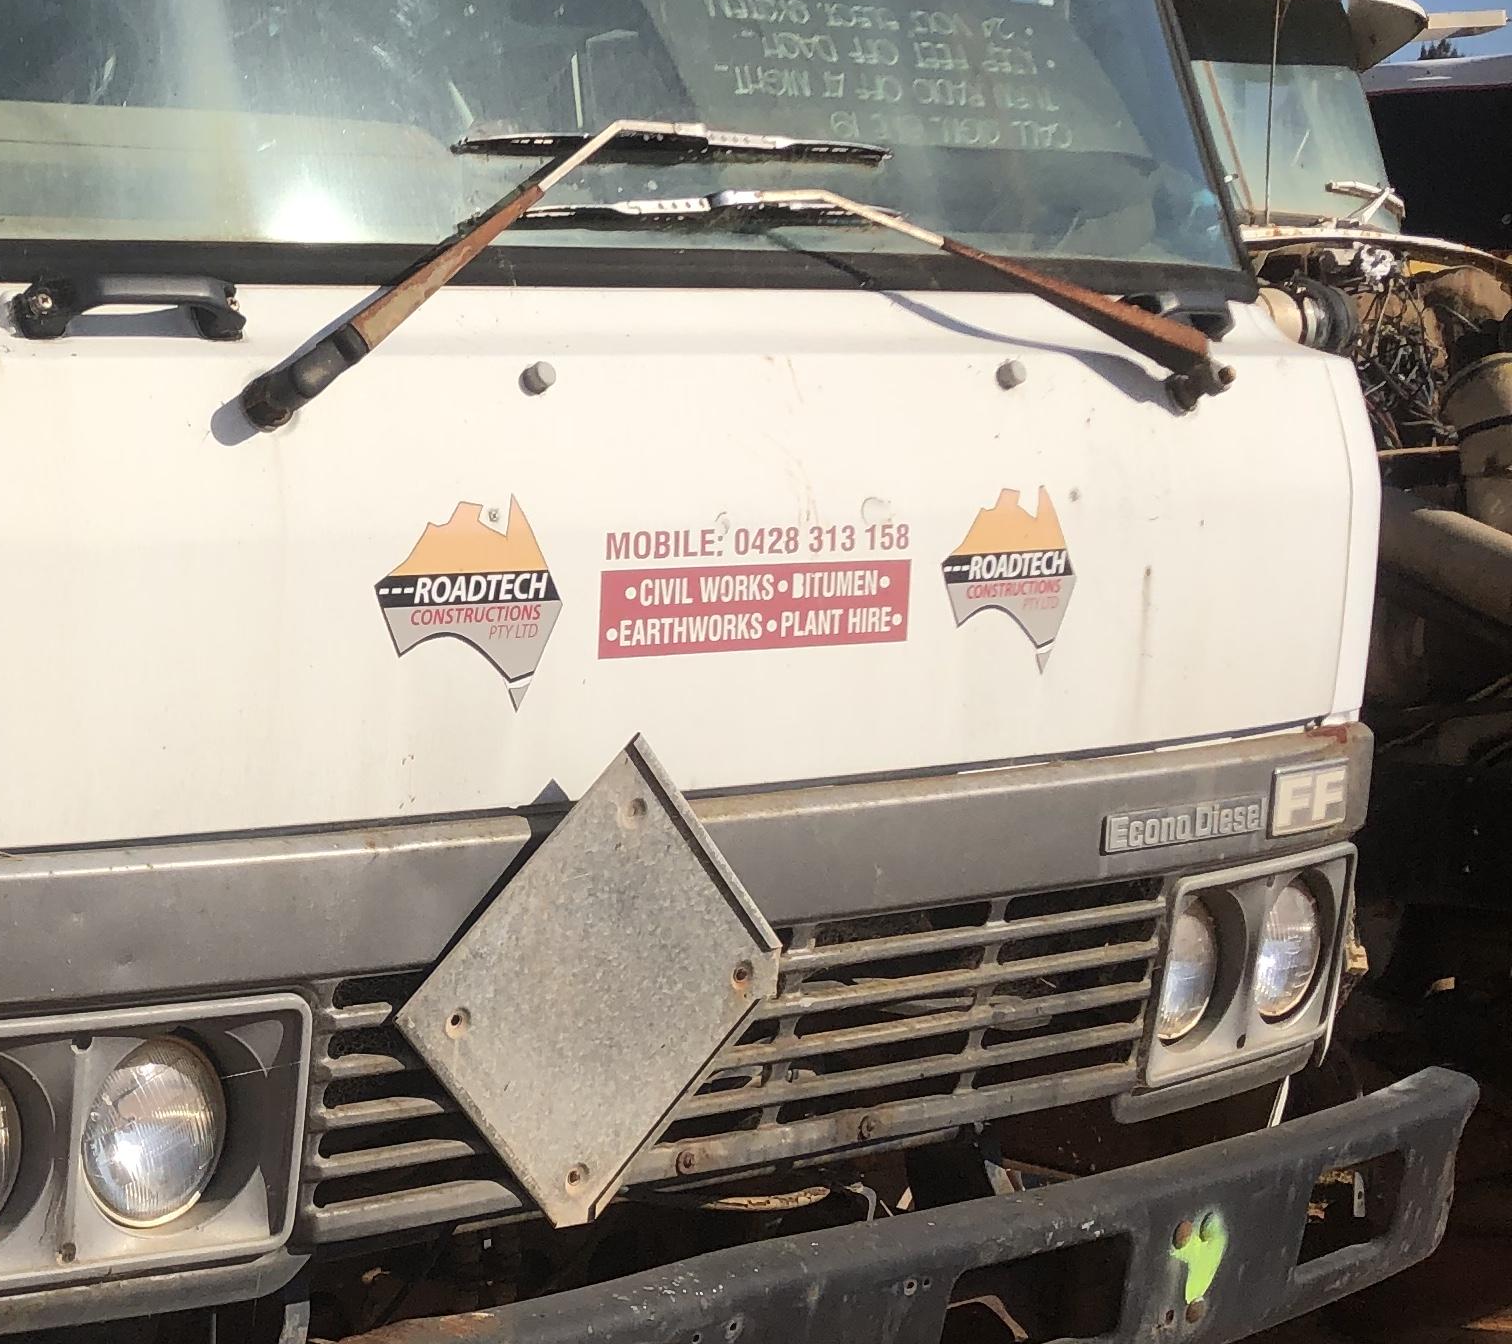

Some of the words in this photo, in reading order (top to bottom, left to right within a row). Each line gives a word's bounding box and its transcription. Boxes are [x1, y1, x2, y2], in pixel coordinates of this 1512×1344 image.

[605, 528, 724, 560] MOBILE:
[734, 526, 800, 556] 0428
[808, 524, 856, 553] 313
[864, 523, 910, 551] 158
[968, 550, 1067, 581] ROADTECH
[414, 572, 548, 604] ROADTECH
[699, 573, 774, 603] WORKS
[791, 569, 879, 599] BITUMEN
[966, 579, 1062, 600] CONSTRUCTIONS
[411, 604, 541, 626] CONSTRUCTIONS
[780, 608, 844, 637] PLANT
[489, 625, 513, 641] PTY
[515, 623, 539, 639] LTD
[1277, 769, 1345, 827] FF
